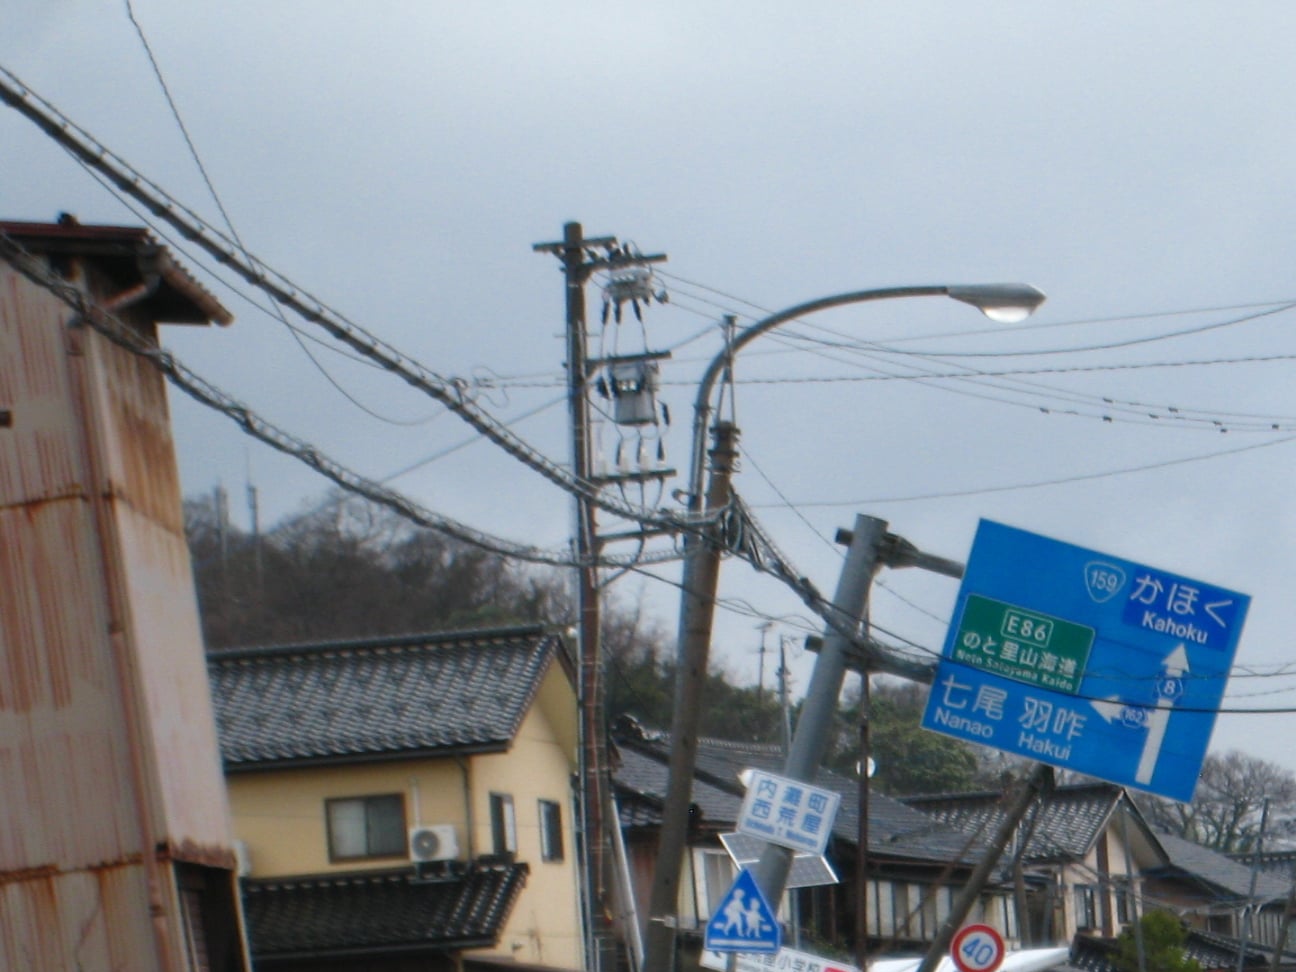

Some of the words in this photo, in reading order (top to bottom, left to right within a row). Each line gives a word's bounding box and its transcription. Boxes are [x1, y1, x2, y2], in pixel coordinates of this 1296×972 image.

[1090, 569, 1118, 593] 159
[1130, 574, 1234, 629] かほく
[1006, 615, 1047, 641] E86
[1143, 611, 1208, 645] Kahoku
[1163, 680, 1175, 695] 8
[941, 673, 1008, 721] 七尾
[1018, 696, 1087, 741] 羽咋
[934, 708, 994, 739] Nanao
[1018, 732, 1072, 762] Hakui
[962, 934, 993, 966] 40
